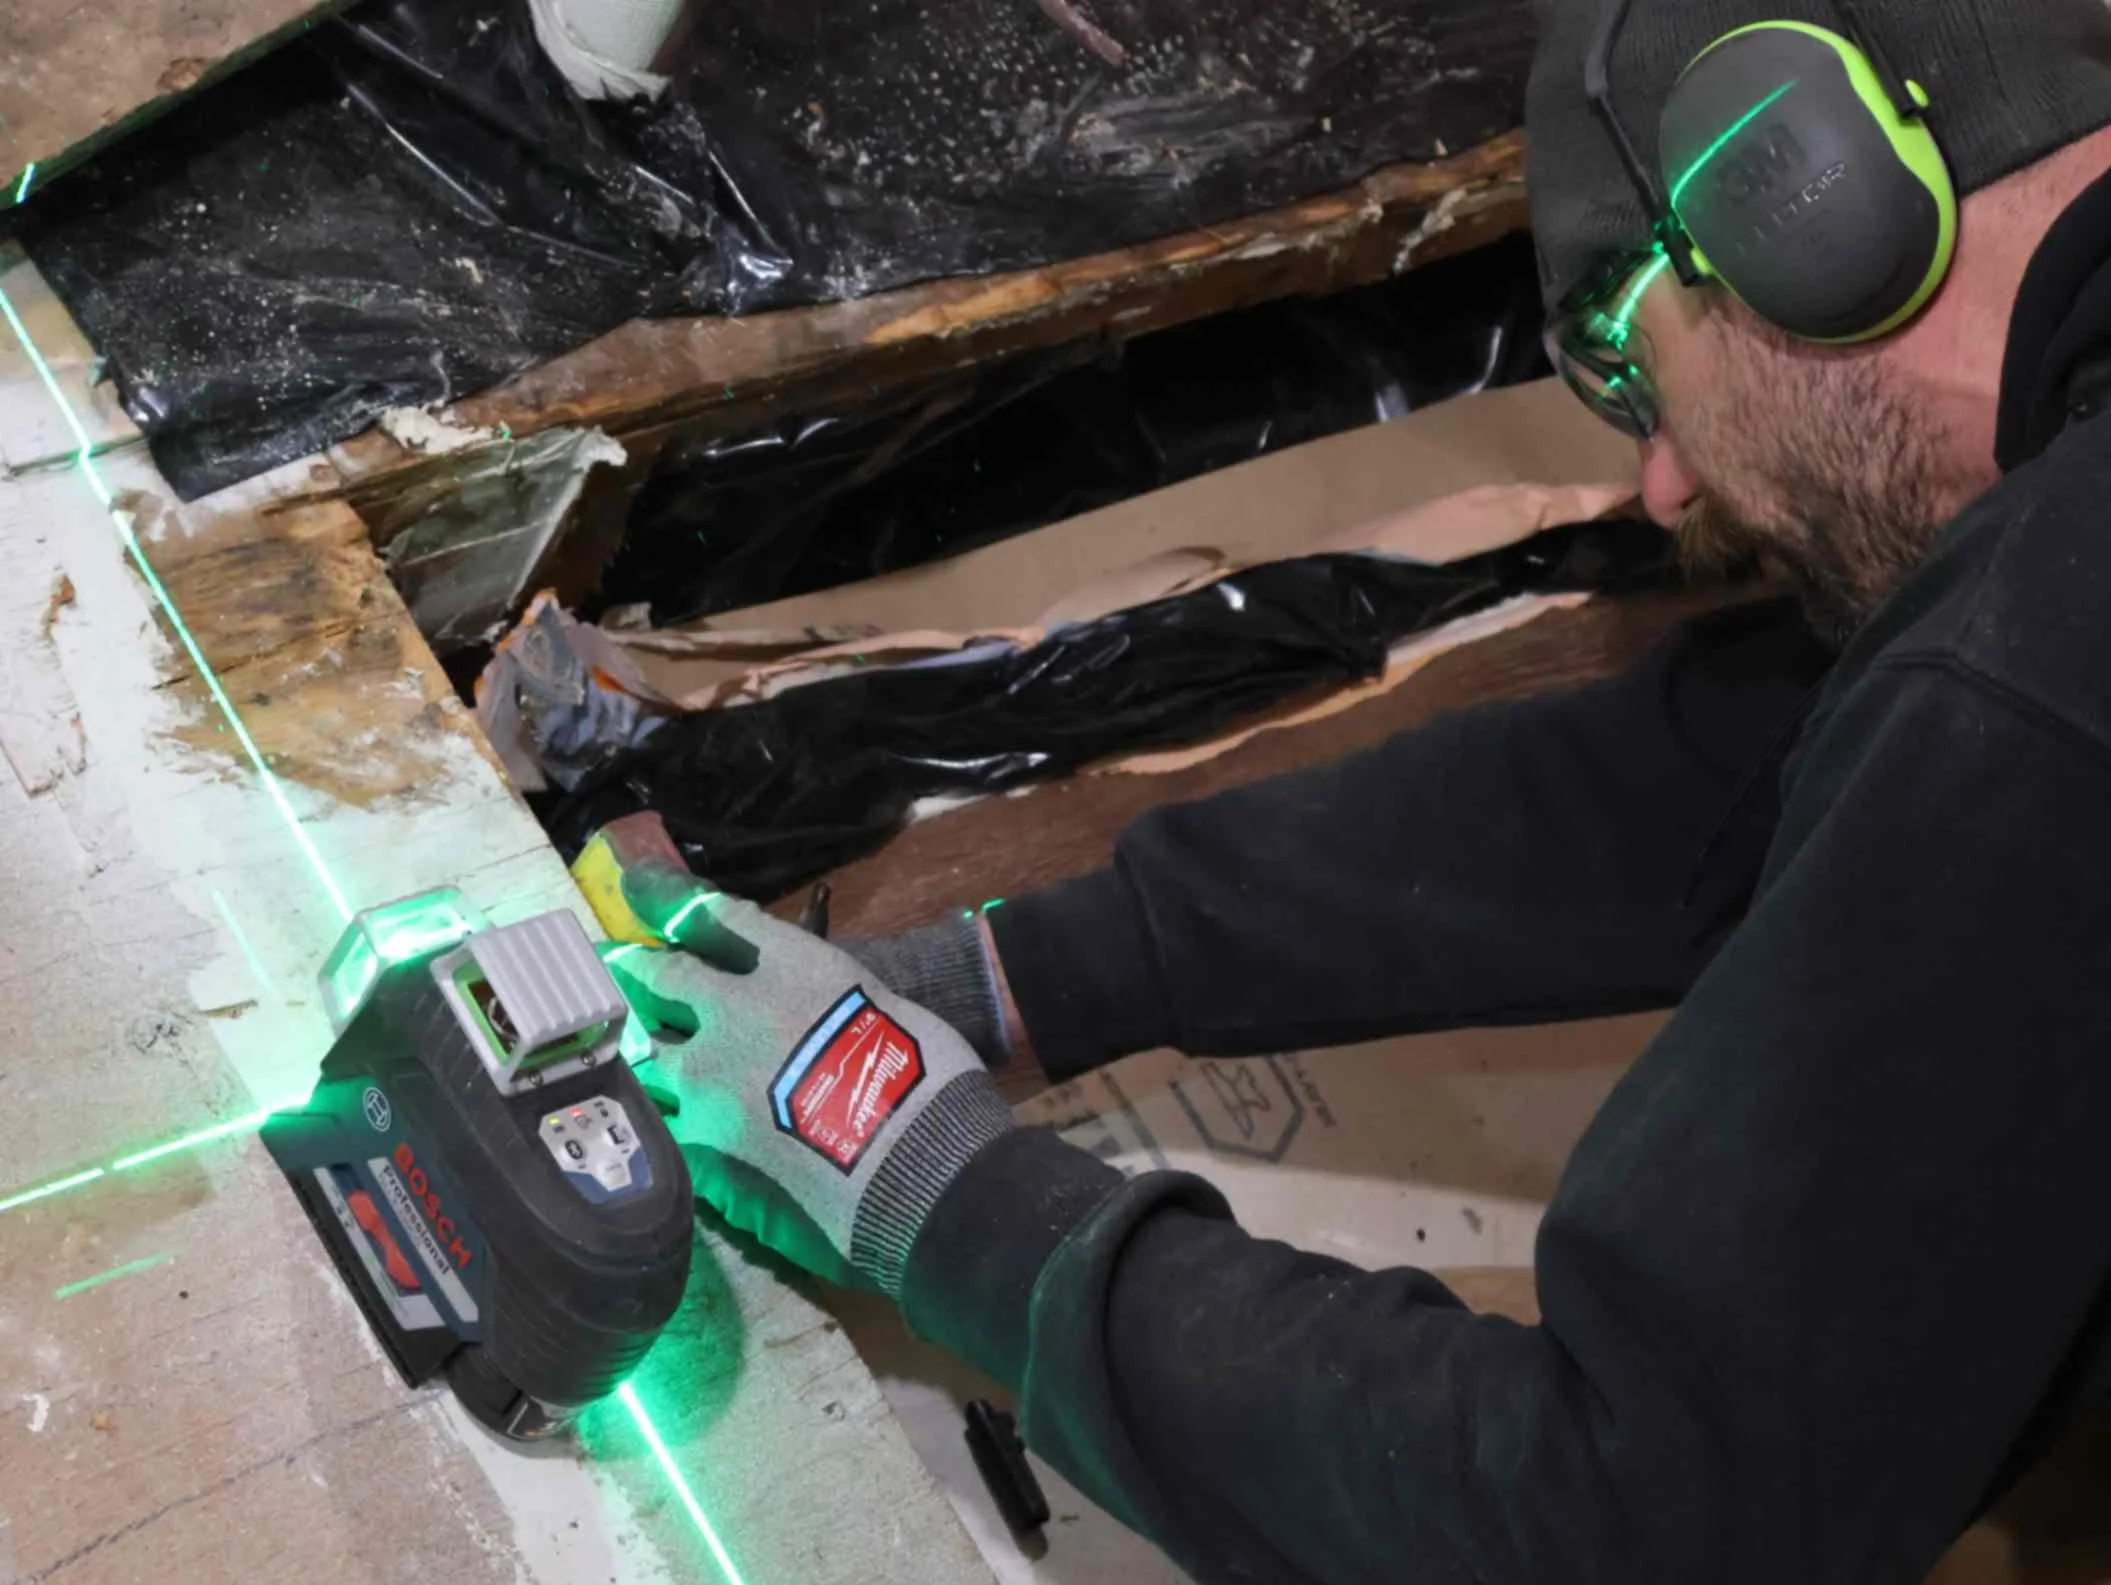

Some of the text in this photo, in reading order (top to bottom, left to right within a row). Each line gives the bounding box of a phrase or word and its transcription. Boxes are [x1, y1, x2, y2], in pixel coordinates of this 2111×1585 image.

[853, 1040, 909, 1131] Milwaukee
[383, 1164, 451, 1275] Professional
[394, 1143, 472, 1268] BOSCH
